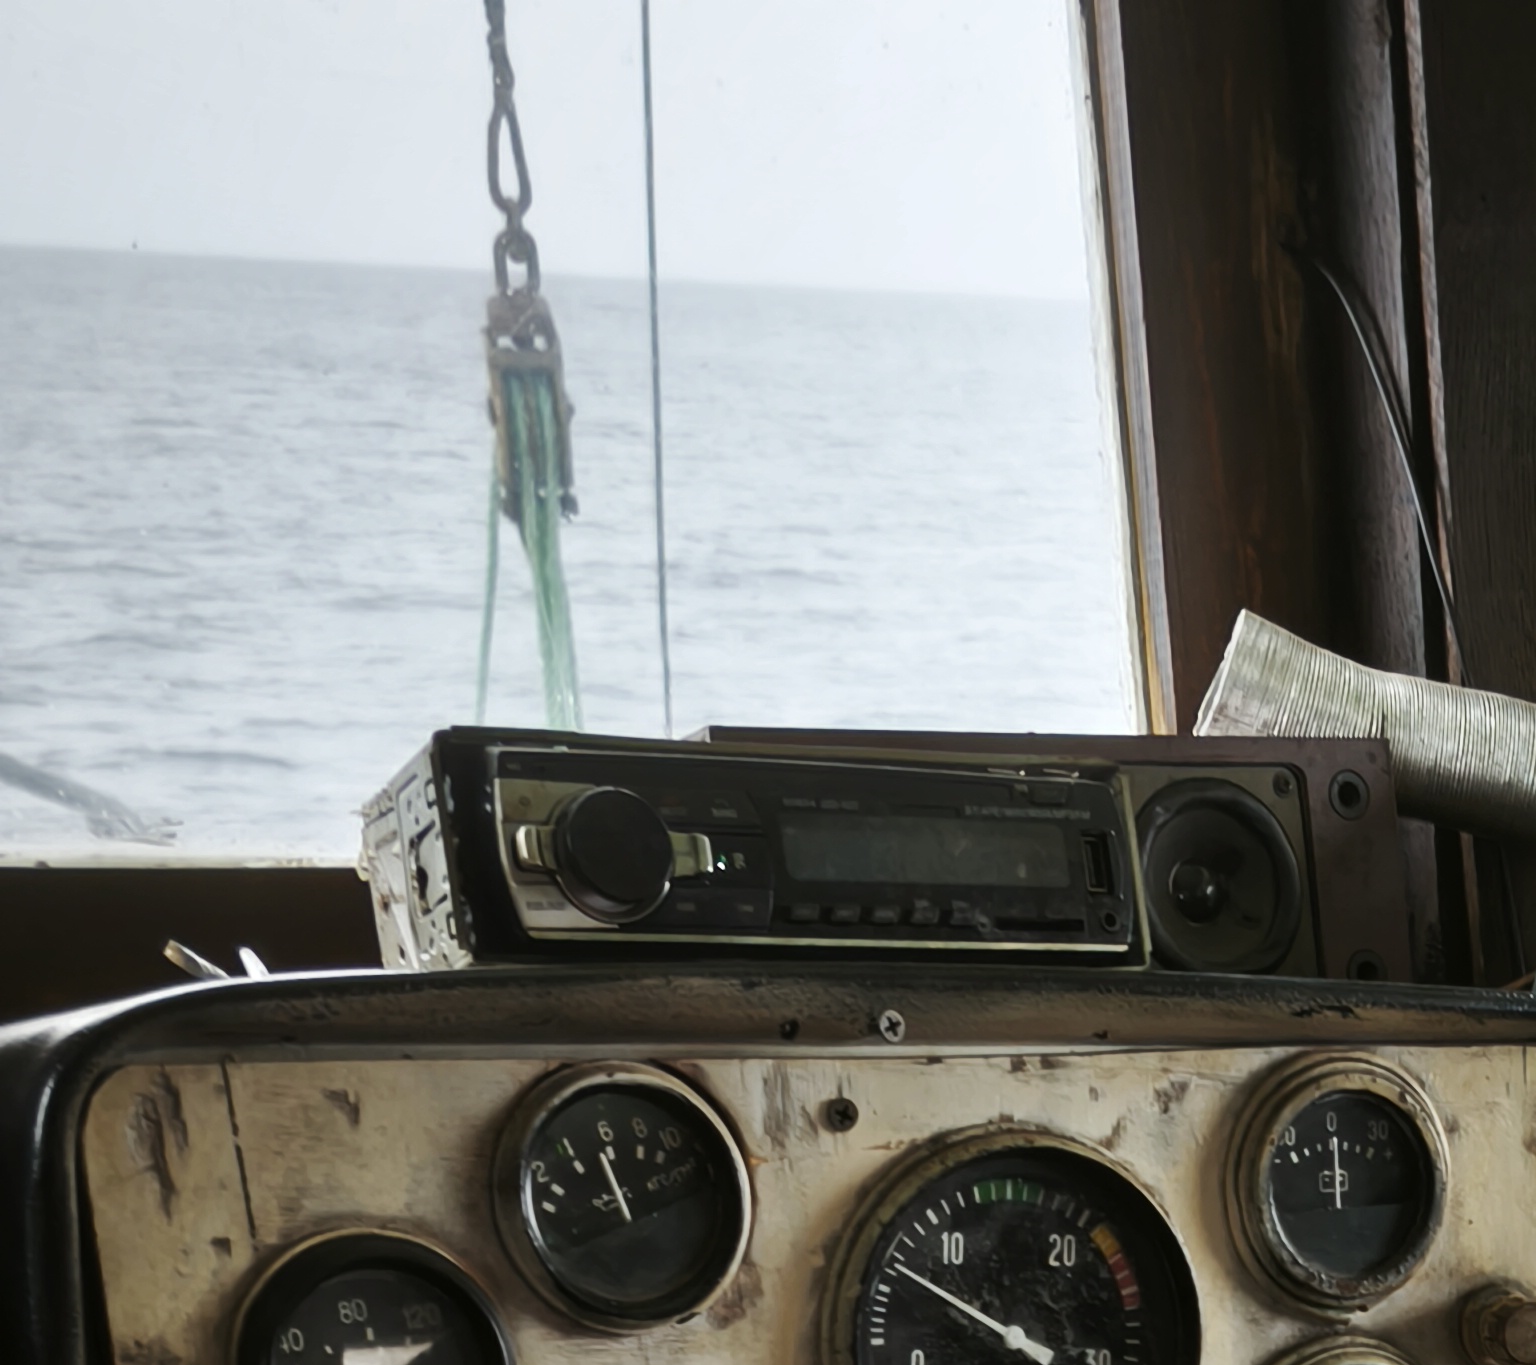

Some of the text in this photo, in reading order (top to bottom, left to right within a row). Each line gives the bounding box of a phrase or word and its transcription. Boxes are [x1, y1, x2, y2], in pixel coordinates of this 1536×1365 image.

[596, 1119, 615, 1143] 6
[630, 1116, 649, 1139] 8
[657, 1126, 683, 1151] 10
[1326, 1111, 1390, 1141] 0 30
[941, 1231, 1076, 1267] 10 20
[337, 1298, 368, 1325] 80
[402, 1302, 443, 1330] 120
